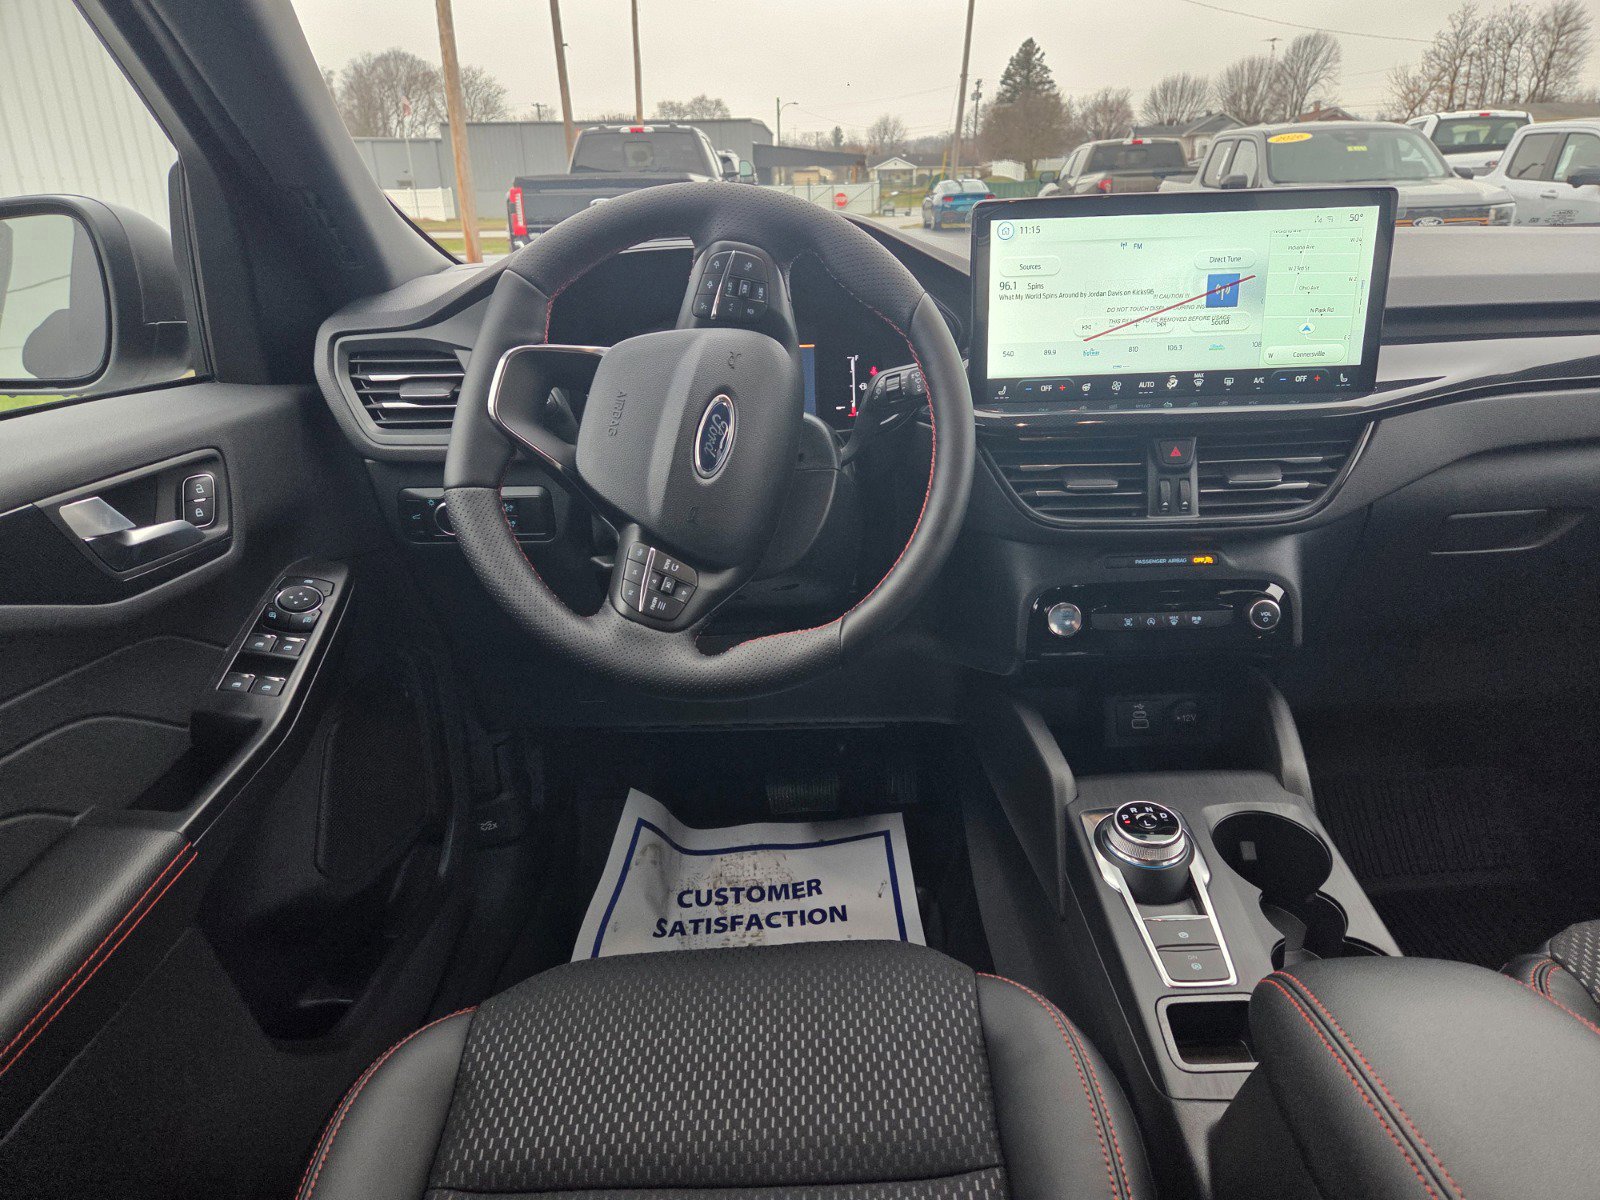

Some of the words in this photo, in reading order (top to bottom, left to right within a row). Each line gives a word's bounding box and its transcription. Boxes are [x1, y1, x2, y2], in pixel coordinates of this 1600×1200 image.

[1349, 213, 1364, 222] 50°
[1019, 225, 1041, 235] 11:15
[1227, 255, 1242, 263] Tune
[1019, 263, 1042, 271] Sources
[999, 281, 1017, 291] 96.1
[1027, 282, 1045, 291] Spins
[1015, 293, 1023, 301] My
[1042, 292, 1058, 300] Spins
[1058, 291, 1079, 299] Around
[1079, 291, 1087, 299] by
[1088, 290, 1107, 298] Jordan
[1107, 289, 1123, 297] Davis
[1211, 318, 1230, 326] Sound
[1128, 345, 1139, 353] 810
[1002, 350, 1015, 358] 540
[1292, 350, 1326, 358] Connersville
[1040, 384, 1053, 392] OFF
[1138, 381, 1155, 389] AUTO
[608, 391, 628, 437] AIRBAG
[649, 597, 658, 611] MENU
[1182, 714, 1197, 722] 12V
[677, 878, 823, 909] CUSTOMER
[652, 904, 848, 938] SATISFACTION
